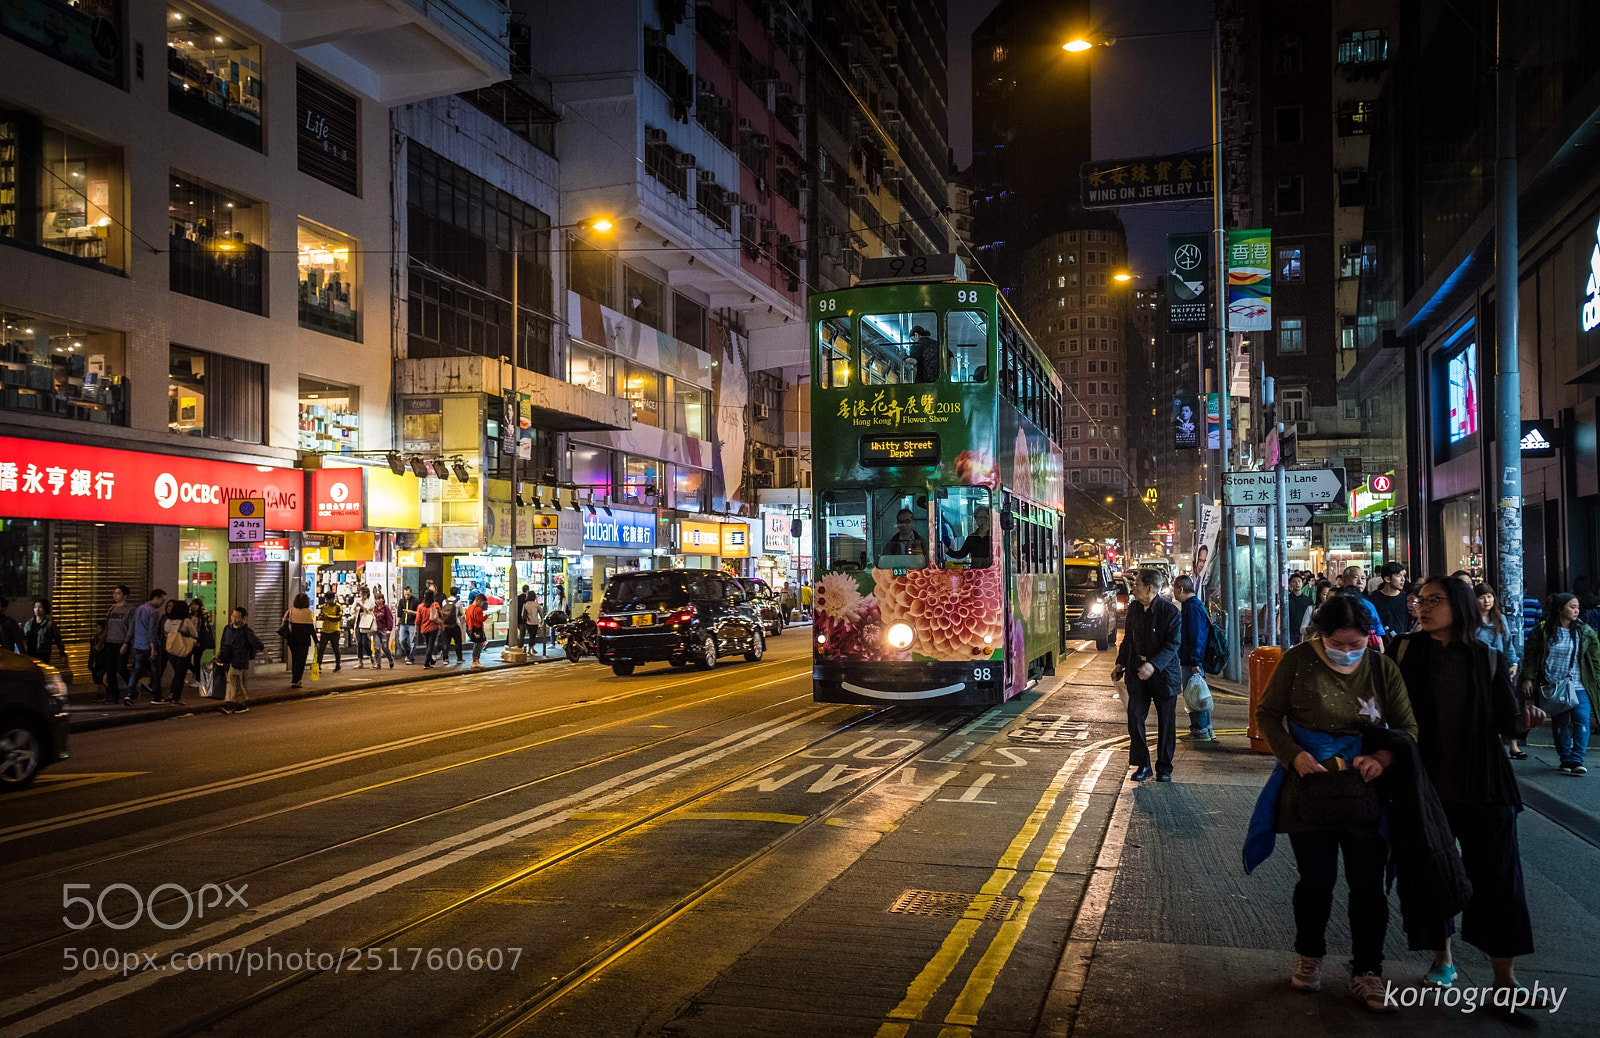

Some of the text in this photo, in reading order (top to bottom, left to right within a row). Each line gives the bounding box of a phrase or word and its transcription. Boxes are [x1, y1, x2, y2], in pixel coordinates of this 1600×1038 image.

[305, 110, 329, 139] Life
[1088, 188, 1117, 202] WING
[1120, 187, 1135, 199] ON
[1138, 182, 1192, 198] JEWELRY
[1232, 243, 1268, 260] 香港
[889, 256, 928, 278] 98
[957, 290, 978, 303] 98
[819, 298, 836, 312] 98
[837, 390, 961, 427] 香港花卉展覽 2018
[852, 415, 949, 427] Hong Kong Flower Show
[871, 441, 933, 451] Whitty Street
[889, 450, 914, 458] Depot
[1226, 474, 1318, 485] Stone Nulh Lane
[180, 482, 220, 505] OCBC
[233, 520, 261, 528] 24 hrs
[236, 530, 257, 540] 全日
[622, 525, 651, 544] 花旗銀行
[973, 668, 992, 681] 98
[801, 738, 1041, 768] STOP
[721, 763, 998, 805] TRAM
